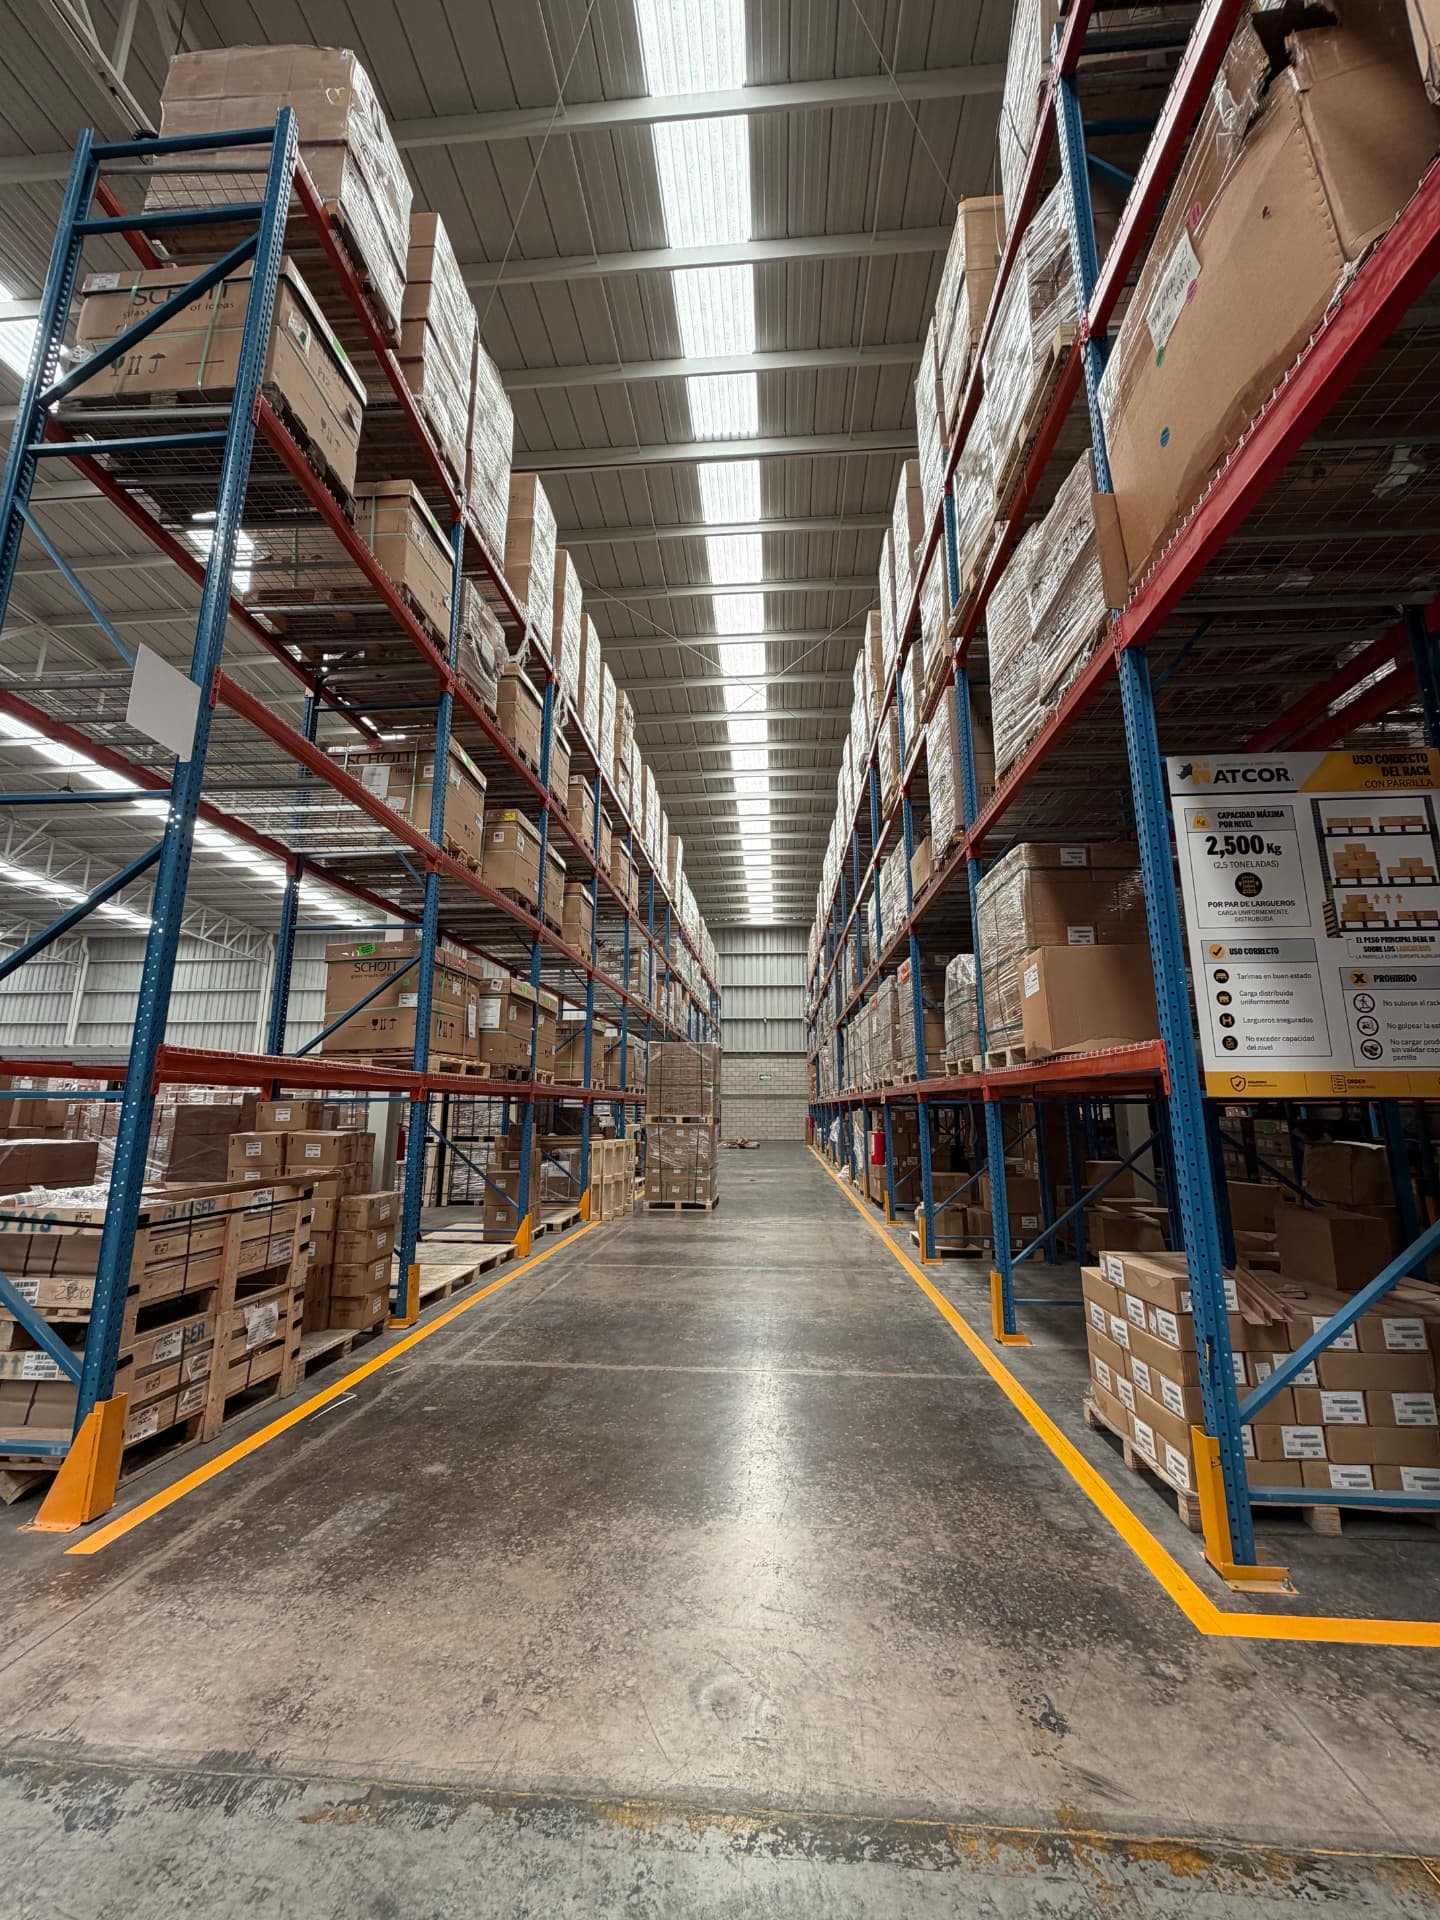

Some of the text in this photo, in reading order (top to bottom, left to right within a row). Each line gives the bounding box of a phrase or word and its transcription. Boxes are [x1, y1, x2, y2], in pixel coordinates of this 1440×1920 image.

[190, 303, 200, 312] of
[1352, 753, 1428, 765] USO CORRECTO
[1382, 765, 1431, 777] DEL RACK
[1364, 779, 1434, 788] CON PARRILLA
[1217, 809, 1284, 819] CAPACIDAD MÁXIMA
[1219, 820, 1254, 828] POR NIVEL
[1205, 835, 1282, 859] 2,500 Kg
[1230, 860, 1280, 869] TONELADAS)
[1240, 900, 1250, 908] DE
[1238, 908, 1289, 916] UNIFORMEMENTE
[1229, 946, 1280, 956] USO CORRECTO
[1363, 945, 1383, 953] SOBRE
[1384, 945, 1396, 953] LOS
[353, 961, 397, 973] SCHOTT
[1373, 974, 1417, 982] PROHIBIDO
[1239, 990, 1258, 998] Carga
[1240, 998, 1290, 1006] uniformemente
[1243, 1017, 1314, 1025] Largueros asegurados
[1397, 1022, 1423, 1031] golpear
[1282, 1035, 1315, 1043] capacidad
